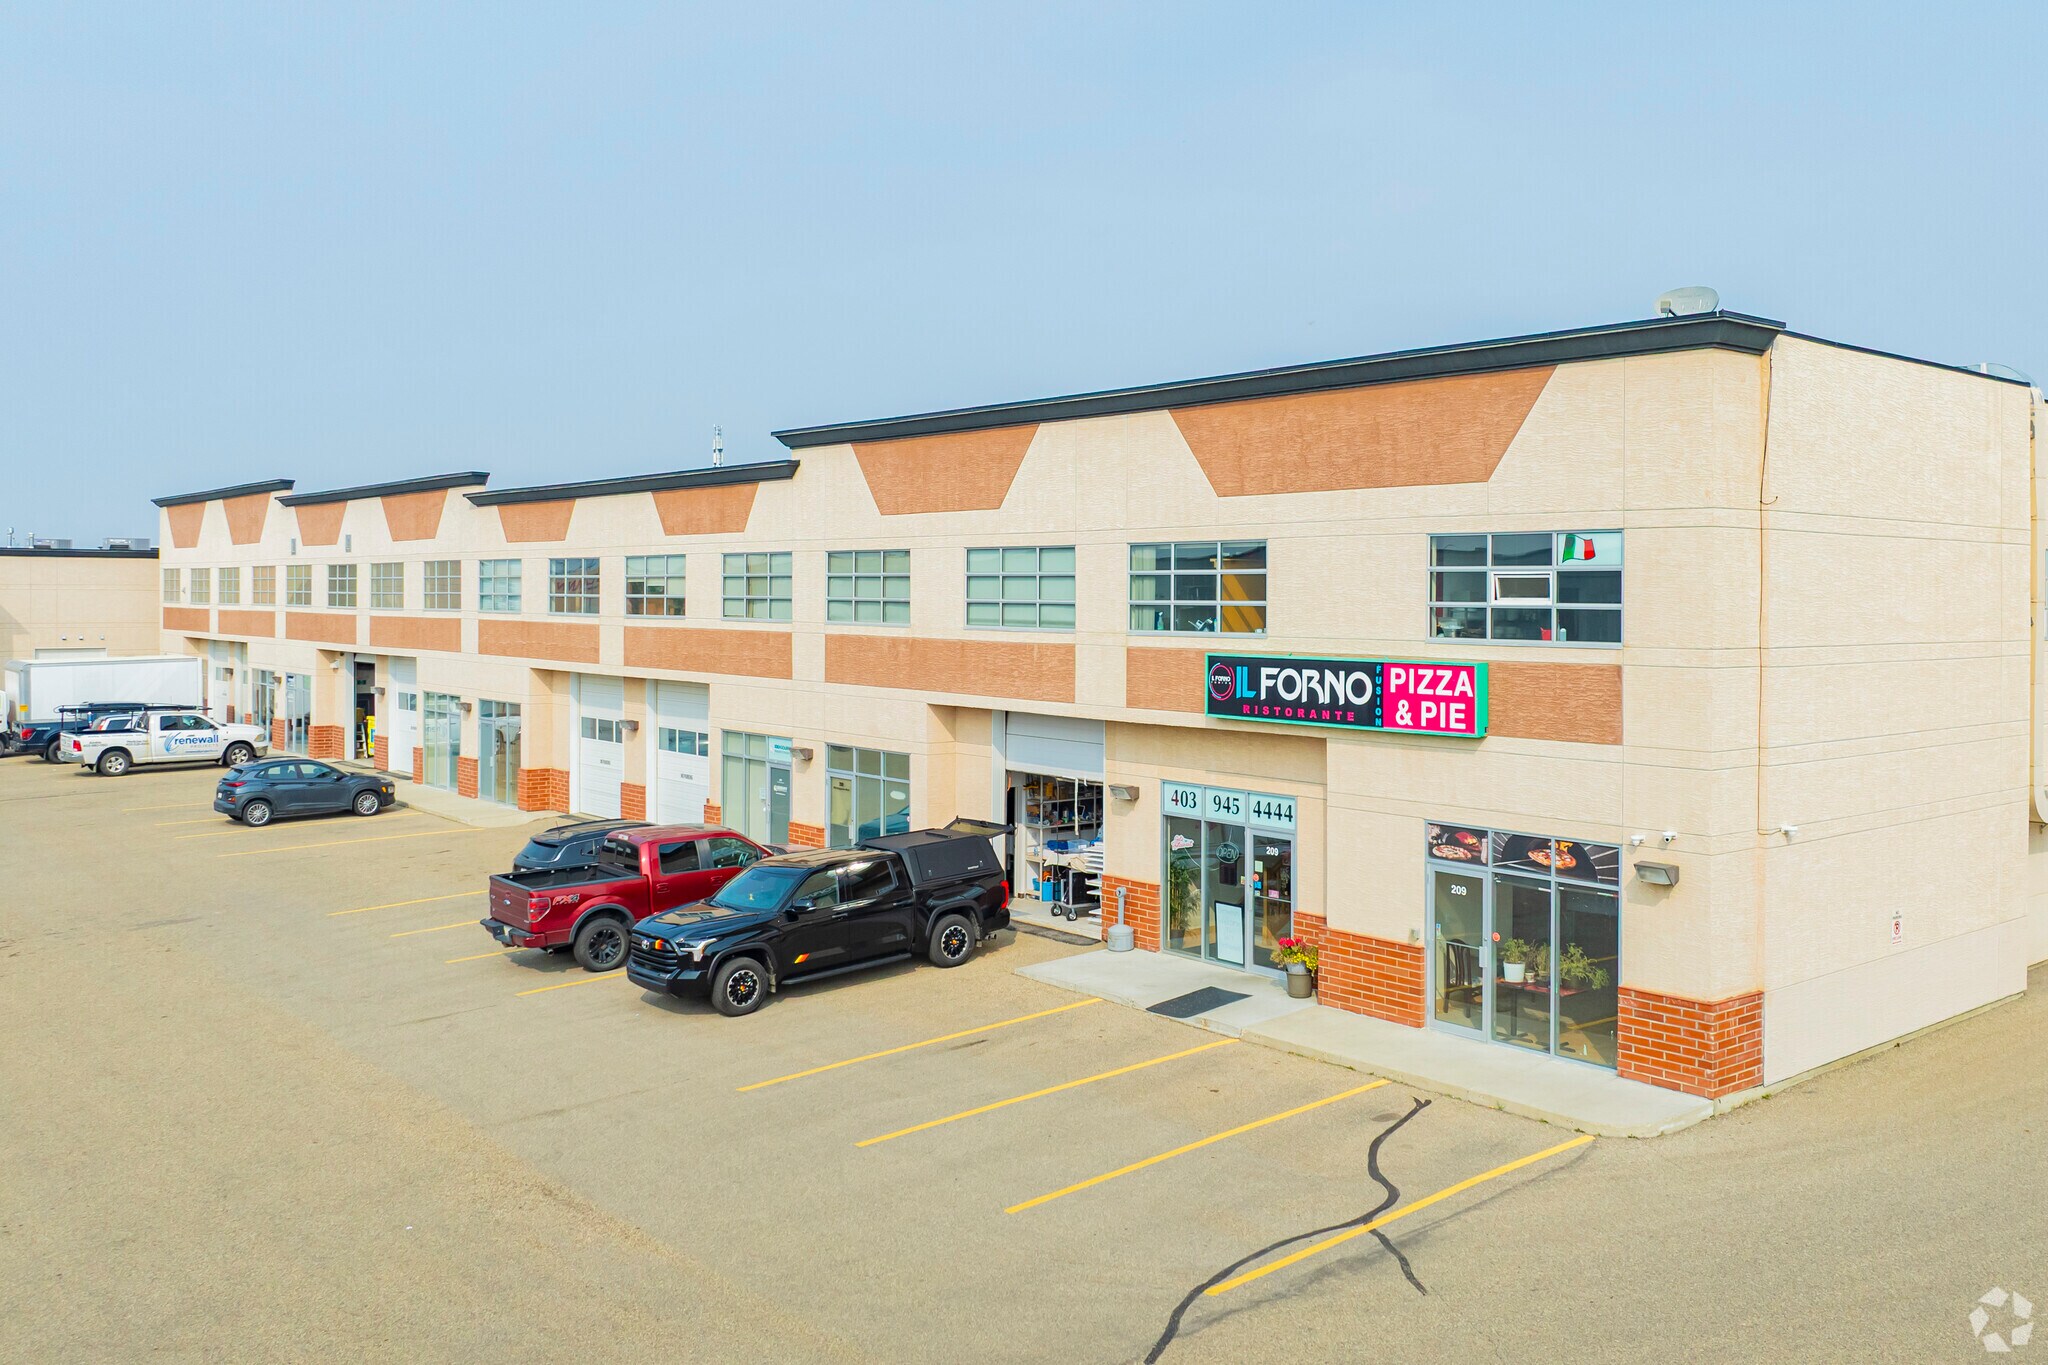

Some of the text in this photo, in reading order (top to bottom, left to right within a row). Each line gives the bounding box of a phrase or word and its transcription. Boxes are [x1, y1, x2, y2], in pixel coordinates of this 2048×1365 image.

[1236, 665, 1373, 706] IL FORNO
[1389, 667, 1474, 698] PIZZA
[1375, 664, 1383, 727] FUSION
[1242, 704, 1355, 721] RISTORANTE
[1395, 700, 1467, 729] & PIE
[174, 734, 219, 745] renewall
[1171, 789, 1293, 823] 403 945 4444
[1219, 845, 1237, 859] OPEN
[1266, 846, 1279, 857] 209
[1451, 884, 1467, 896] 209
[552, 893, 580, 905] FX4
